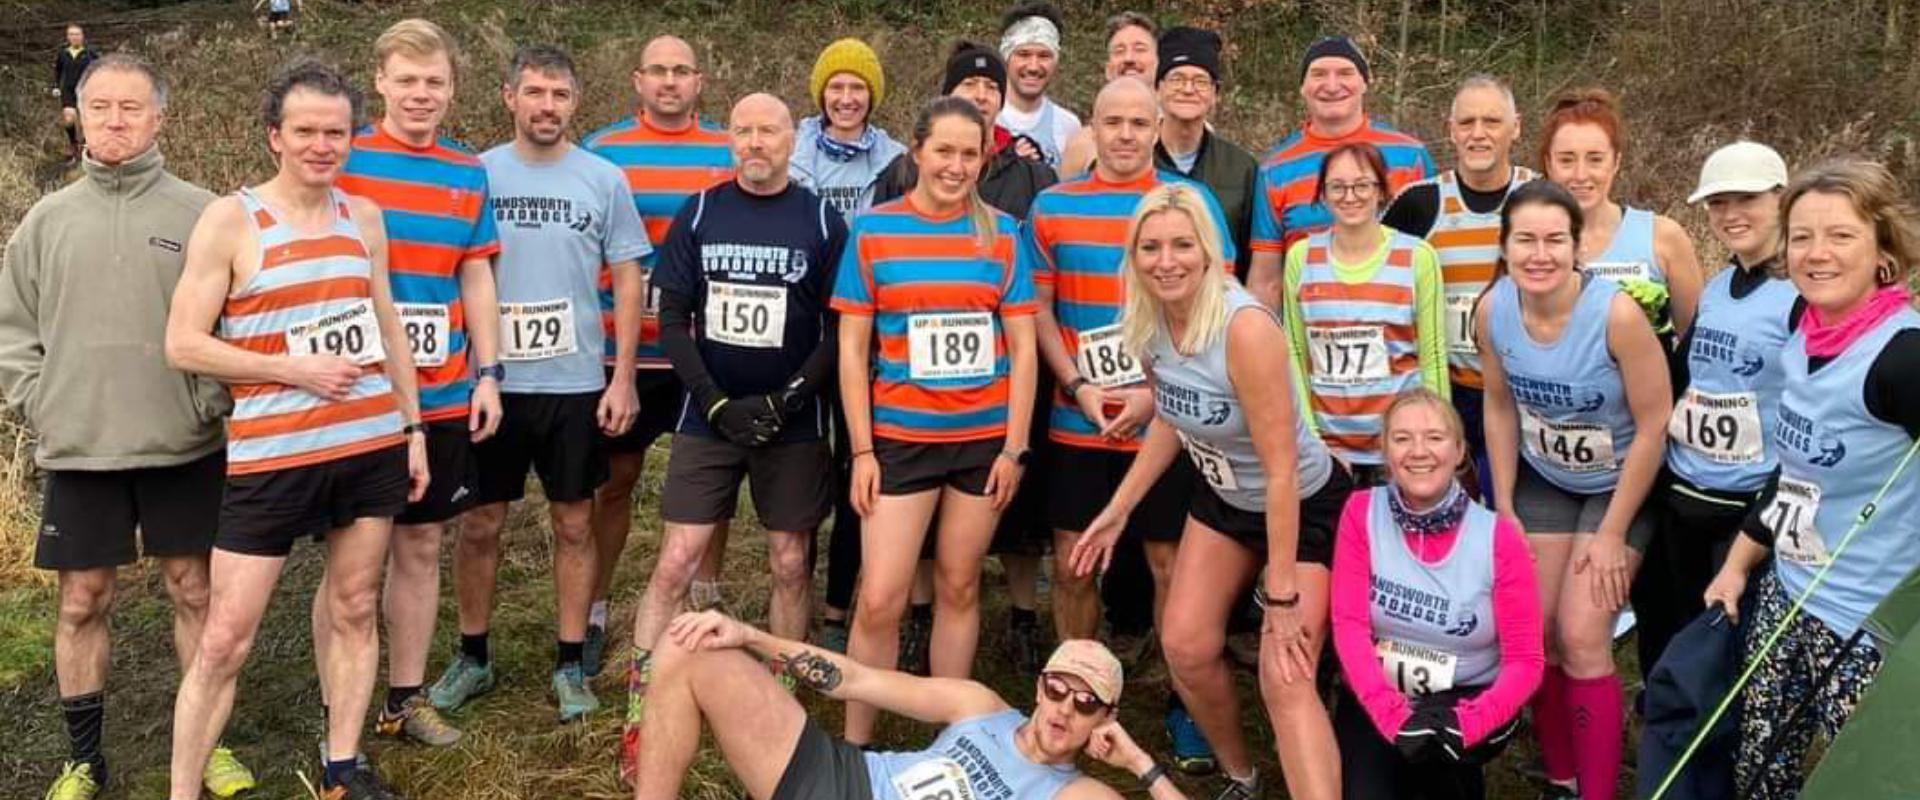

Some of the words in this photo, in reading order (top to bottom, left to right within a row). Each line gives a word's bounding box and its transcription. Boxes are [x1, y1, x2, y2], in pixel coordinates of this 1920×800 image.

[496, 209, 572, 223] OADHOGS
[702, 244, 789, 261] HANDSWORTH
[514, 317, 561, 349] 129
[722, 301, 769, 335] 150
[309, 324, 364, 356] 190
[405, 322, 437, 354] 88
[931, 332, 980, 366] 189
[1086, 341, 1133, 378] 186
[1325, 343, 1369, 374] 177
[1540, 428, 1594, 463] 146
[1686, 408, 1738, 450] 169
[1193, 450, 1223, 486] 23
[1774, 501, 1802, 549] 74
[1370, 575, 1450, 611] ANDSWORTH
[1370, 589, 1447, 626] OADHOGS
